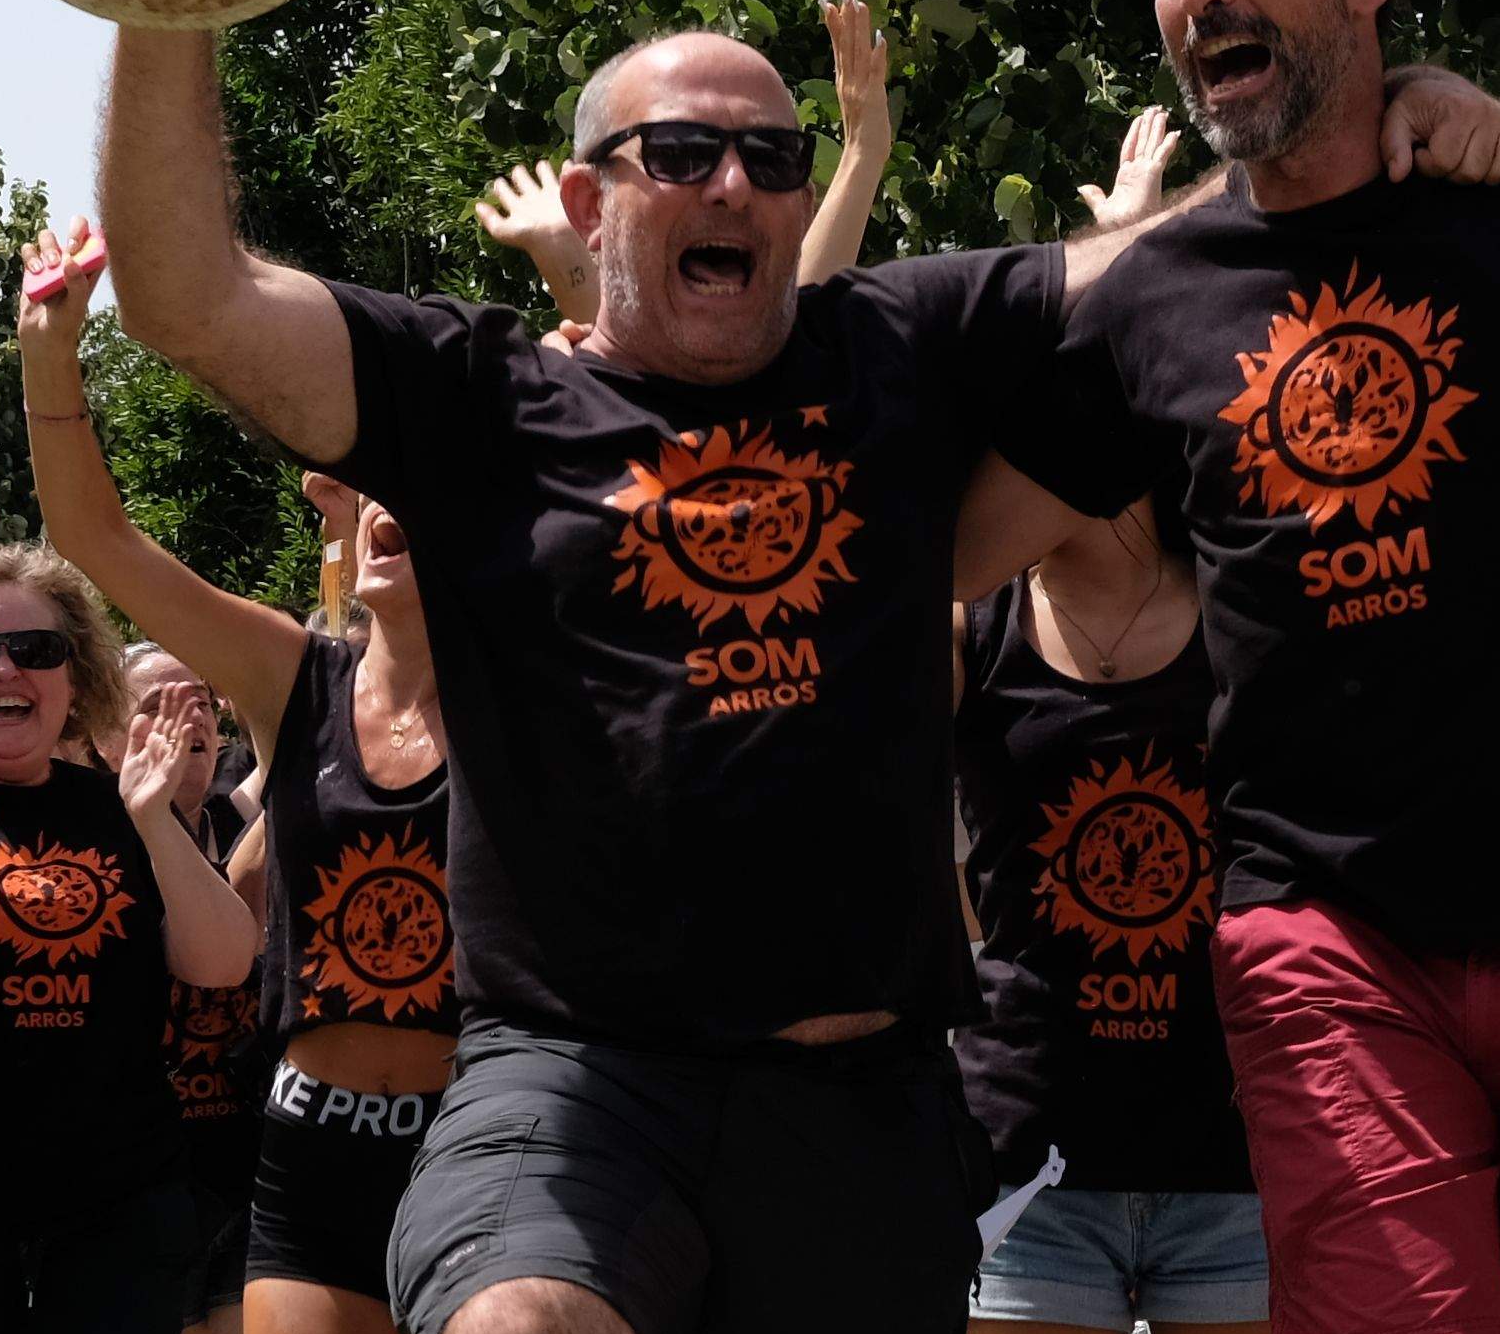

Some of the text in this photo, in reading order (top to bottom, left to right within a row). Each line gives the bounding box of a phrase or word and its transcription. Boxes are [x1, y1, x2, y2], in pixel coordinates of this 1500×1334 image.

[1299, 526, 1431, 598] SOM
[1326, 583, 1428, 630] ARRÒS
[685, 637, 821, 687] SOM
[2, 974, 90, 1006] SOM
[1076, 973, 1177, 1012] SOM
[270, 1057, 424, 1137] KE PRO
